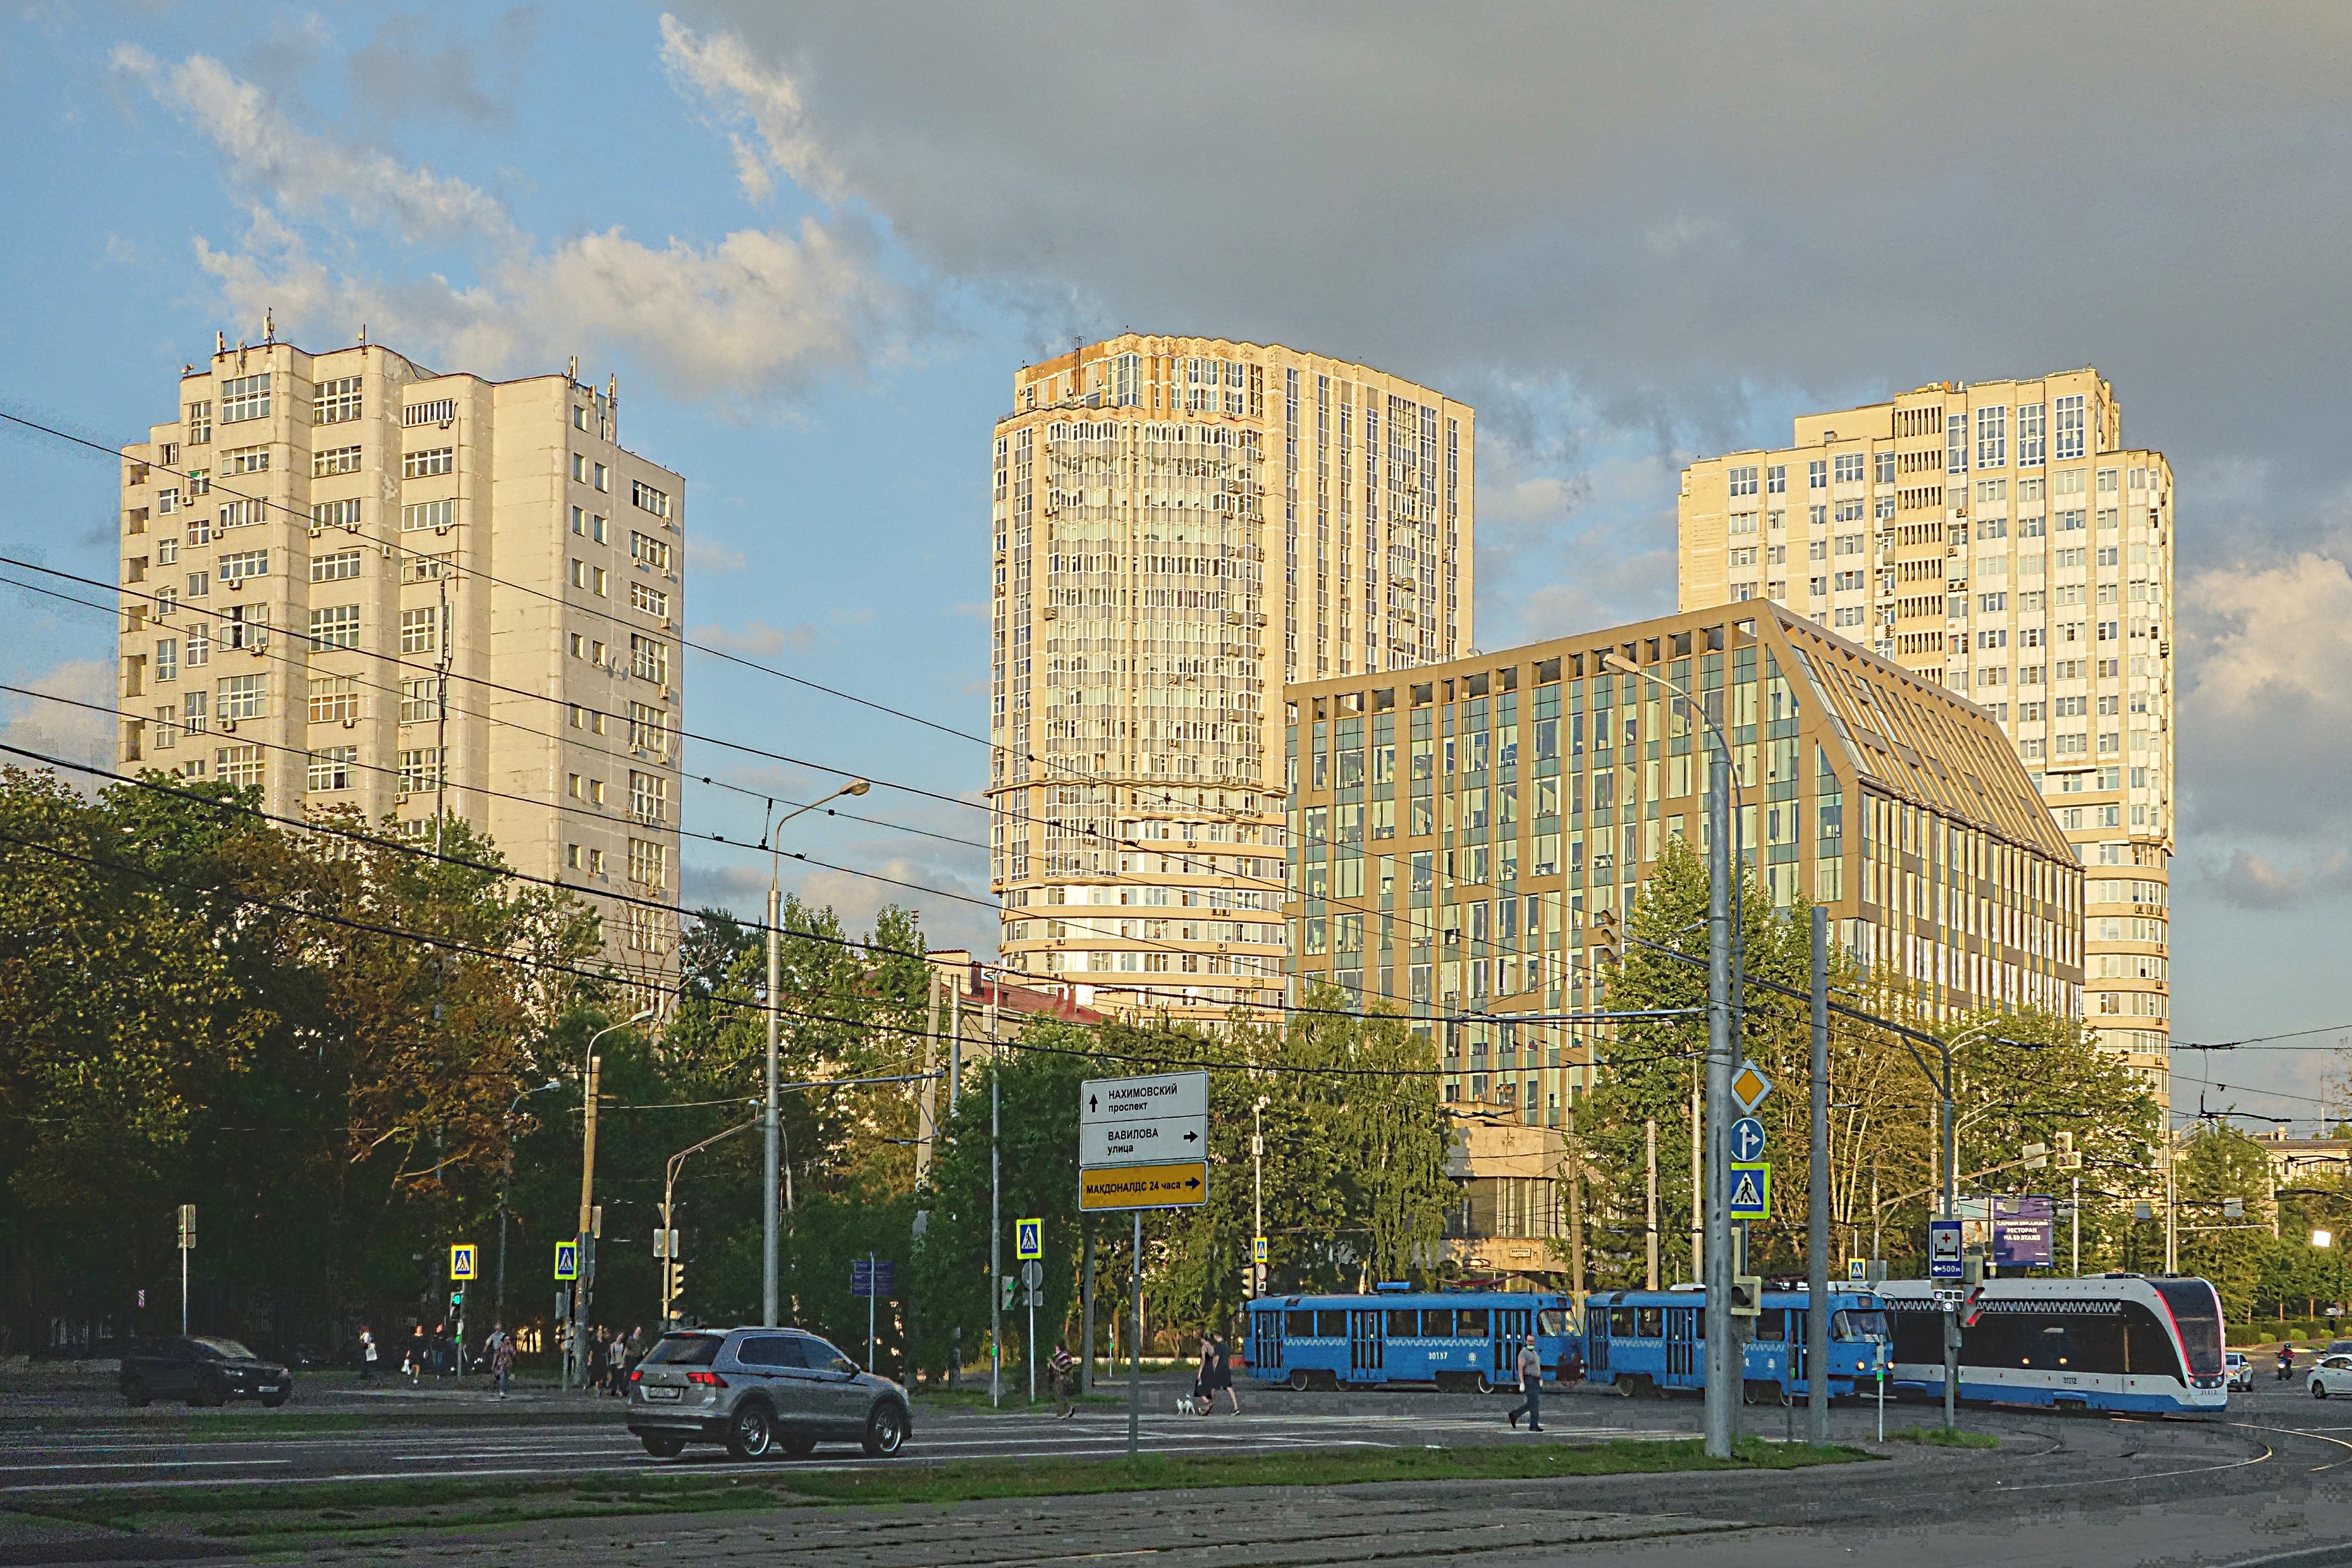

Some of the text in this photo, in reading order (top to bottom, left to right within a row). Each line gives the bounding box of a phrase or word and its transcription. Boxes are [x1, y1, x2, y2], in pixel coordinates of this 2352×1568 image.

[1108, 1083, 1178, 1100] НАХИМОВСКИЙ
[1108, 1102, 1148, 1114] проспект
[1108, 1128, 1158, 1141] ВАВИЛОВА
[1107, 1144, 1134, 1156] улица
[1087, 1181, 1181, 1195] МАКДОНАЛДС 24 часа
